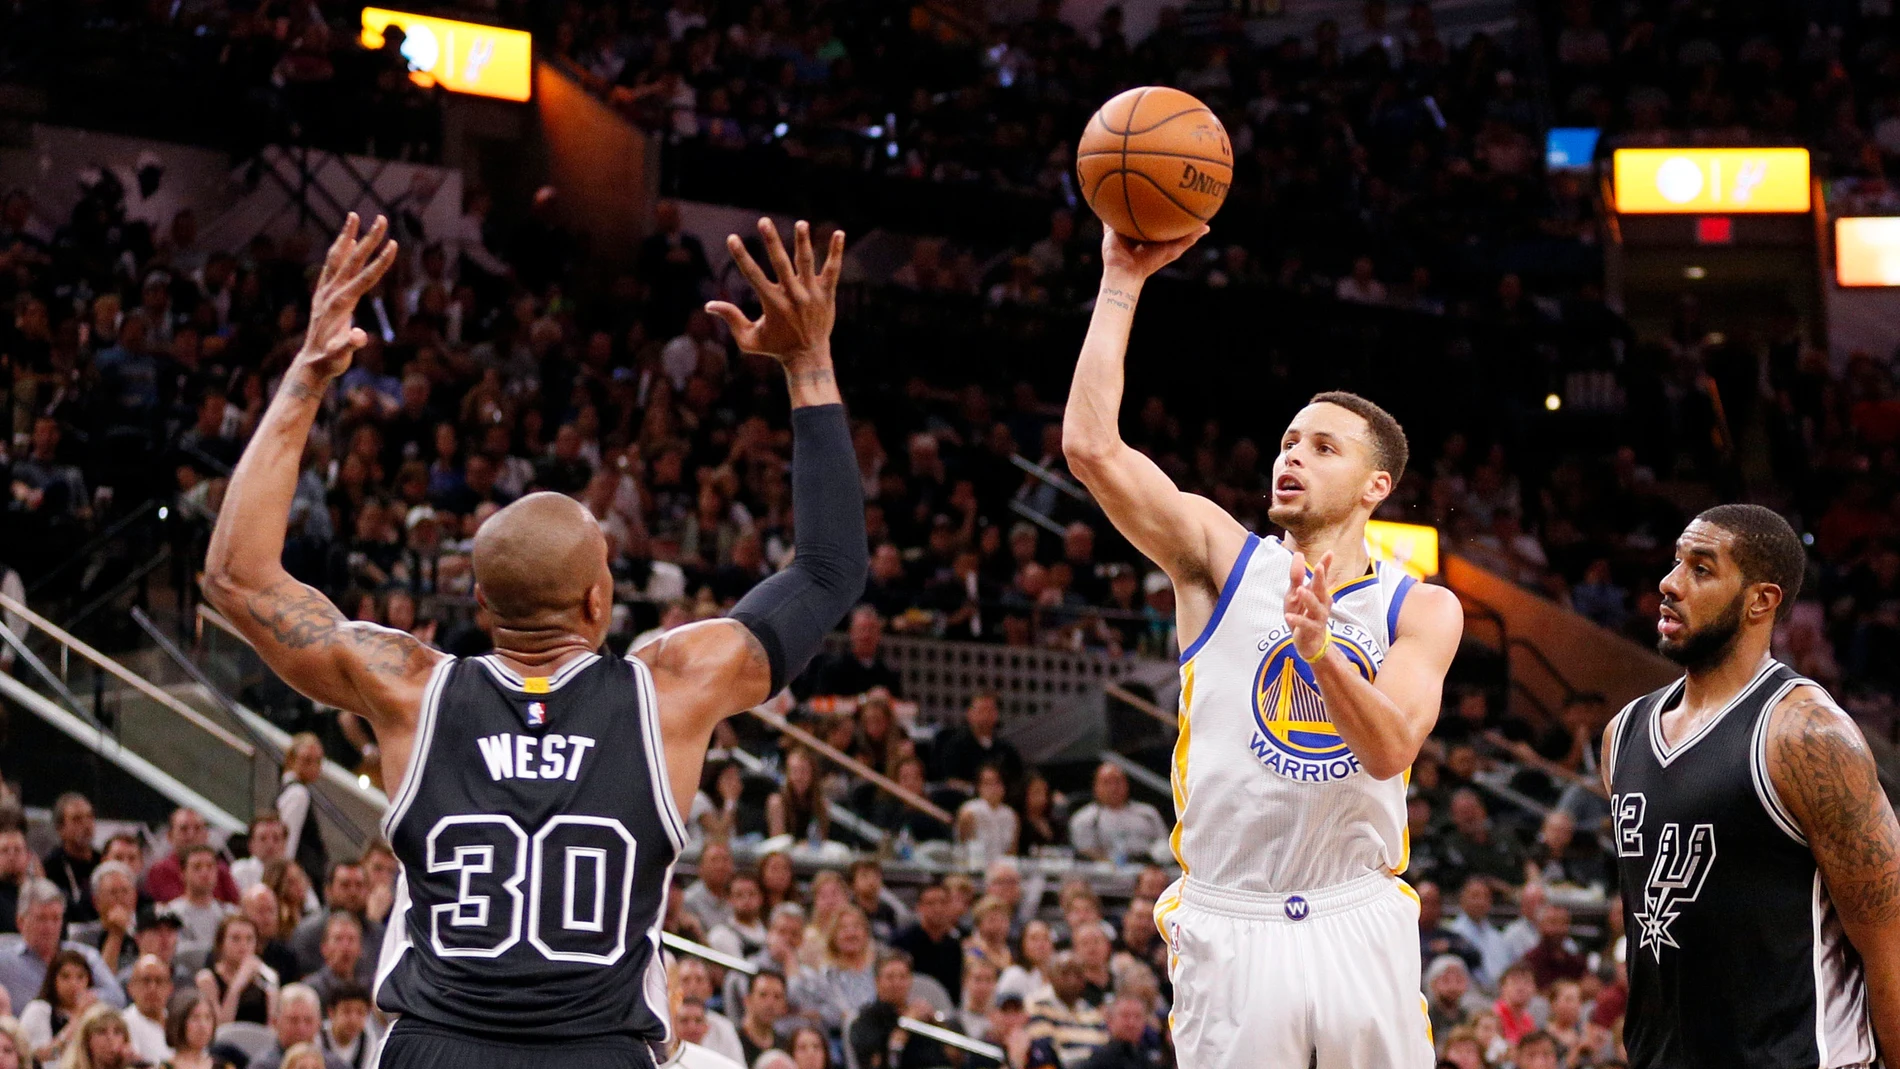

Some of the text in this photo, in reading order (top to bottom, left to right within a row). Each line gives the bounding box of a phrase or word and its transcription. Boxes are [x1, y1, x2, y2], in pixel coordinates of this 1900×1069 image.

[1179, 164, 1229, 198] LDING
[1257, 620, 1335, 652] GOLN
[477, 733, 596, 781] WEST
[1250, 731, 1361, 782] WARRIO
[426, 814, 637, 965] 30
[1286, 902, 1306, 916] W
